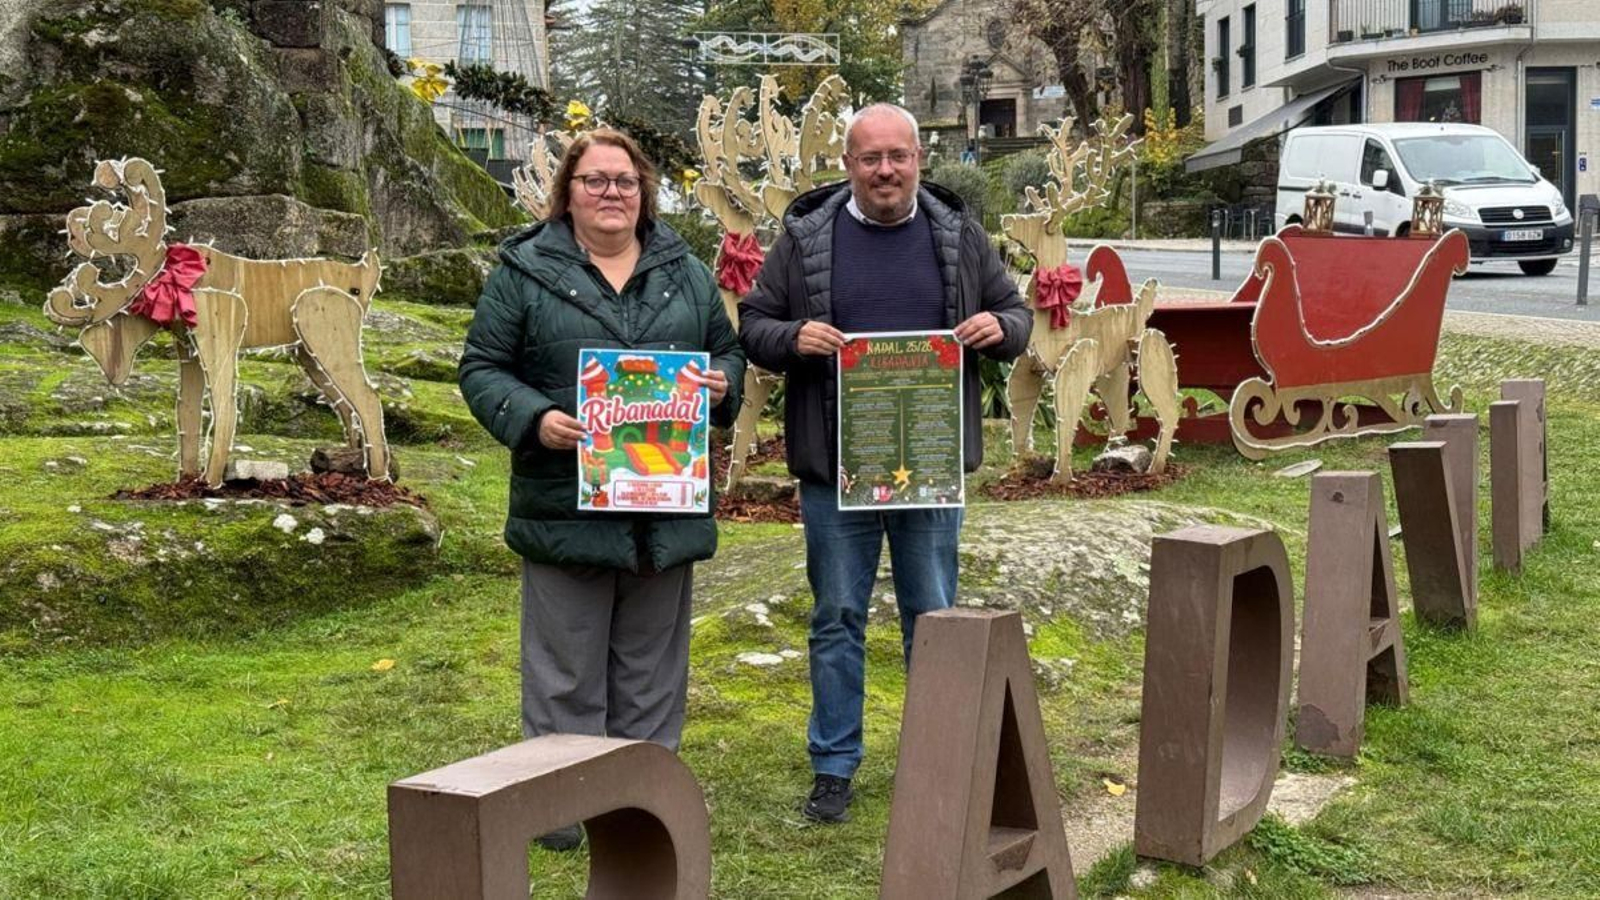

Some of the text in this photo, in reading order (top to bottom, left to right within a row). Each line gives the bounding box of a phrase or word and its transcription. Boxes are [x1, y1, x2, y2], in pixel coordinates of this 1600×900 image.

[1387, 53, 1489, 72] The Boot Coffee
[906, 340, 933, 353] 25/26
[580, 392, 704, 434] Ribanadal
